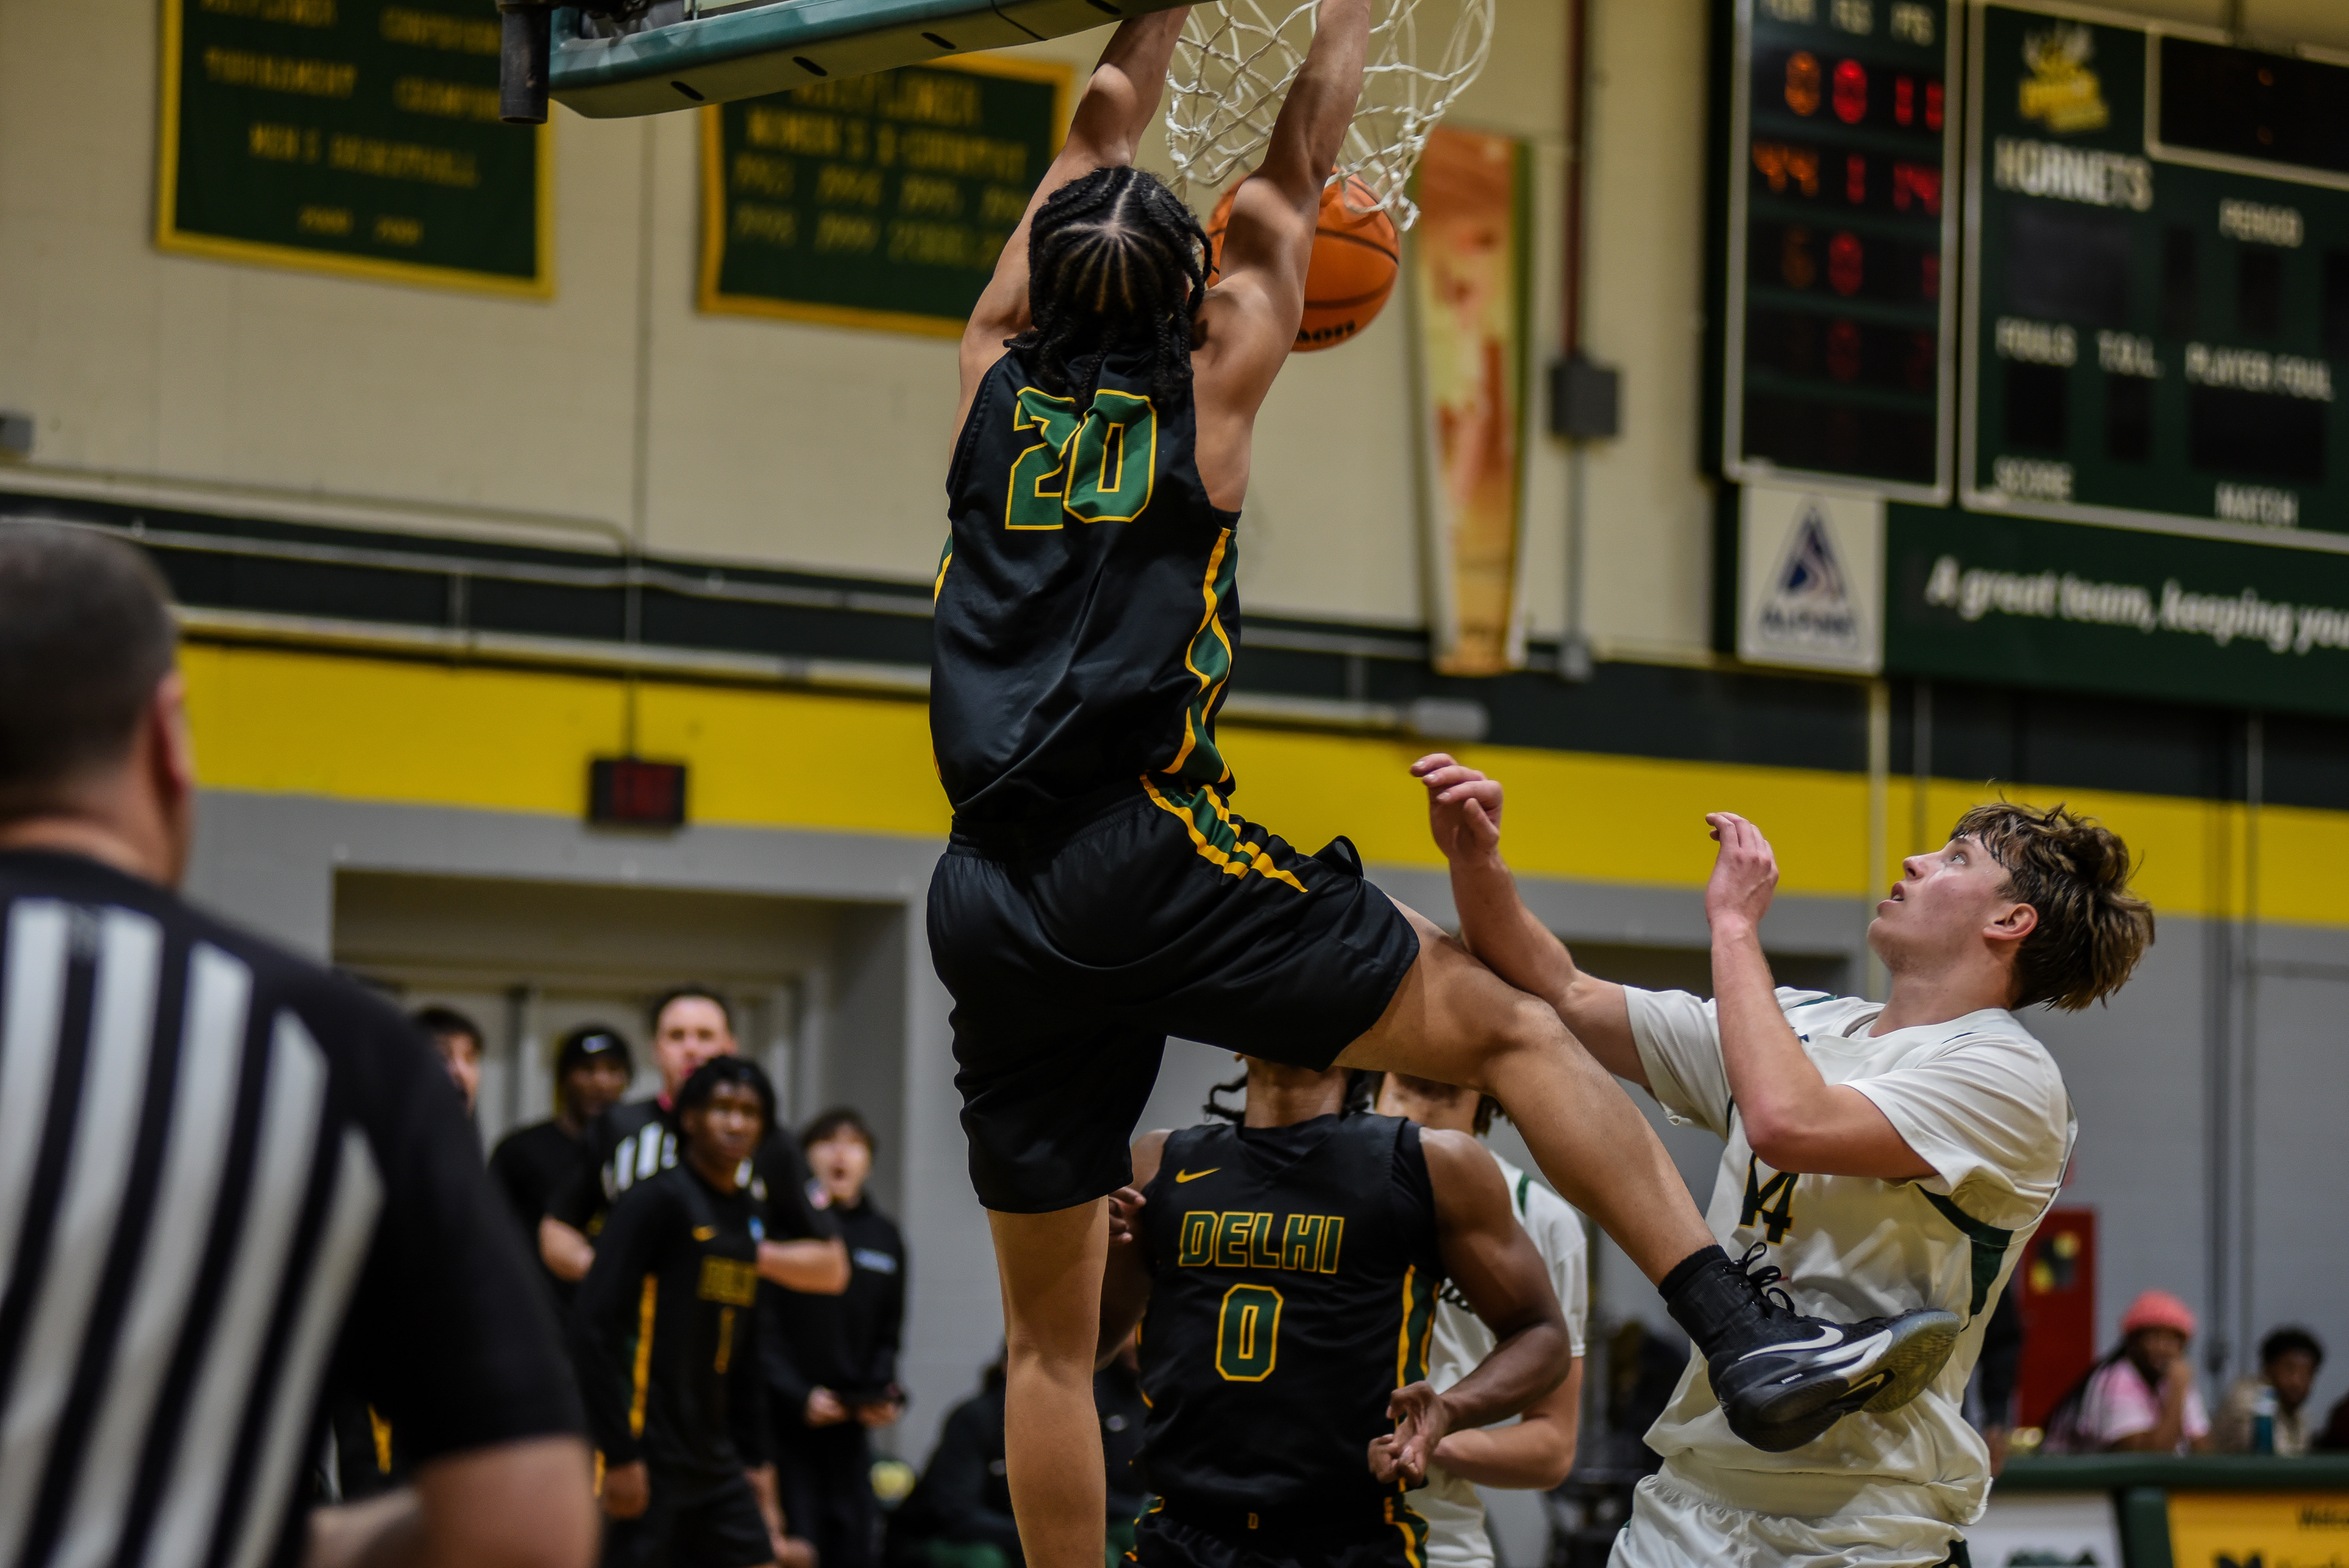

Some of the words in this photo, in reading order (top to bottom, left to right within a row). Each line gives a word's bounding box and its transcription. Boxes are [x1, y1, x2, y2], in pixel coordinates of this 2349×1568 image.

[1994, 138, 2153, 212] HORNETS
[1005, 386, 1157, 530] 20
[1925, 554, 1961, 607] A
[1957, 566, 2057, 622] great
[2059, 571, 2157, 634] team,
[2161, 577, 2295, 655] keeping
[1178, 1210, 1345, 1275] DELHI
[1215, 1283, 1284, 1382] 0
